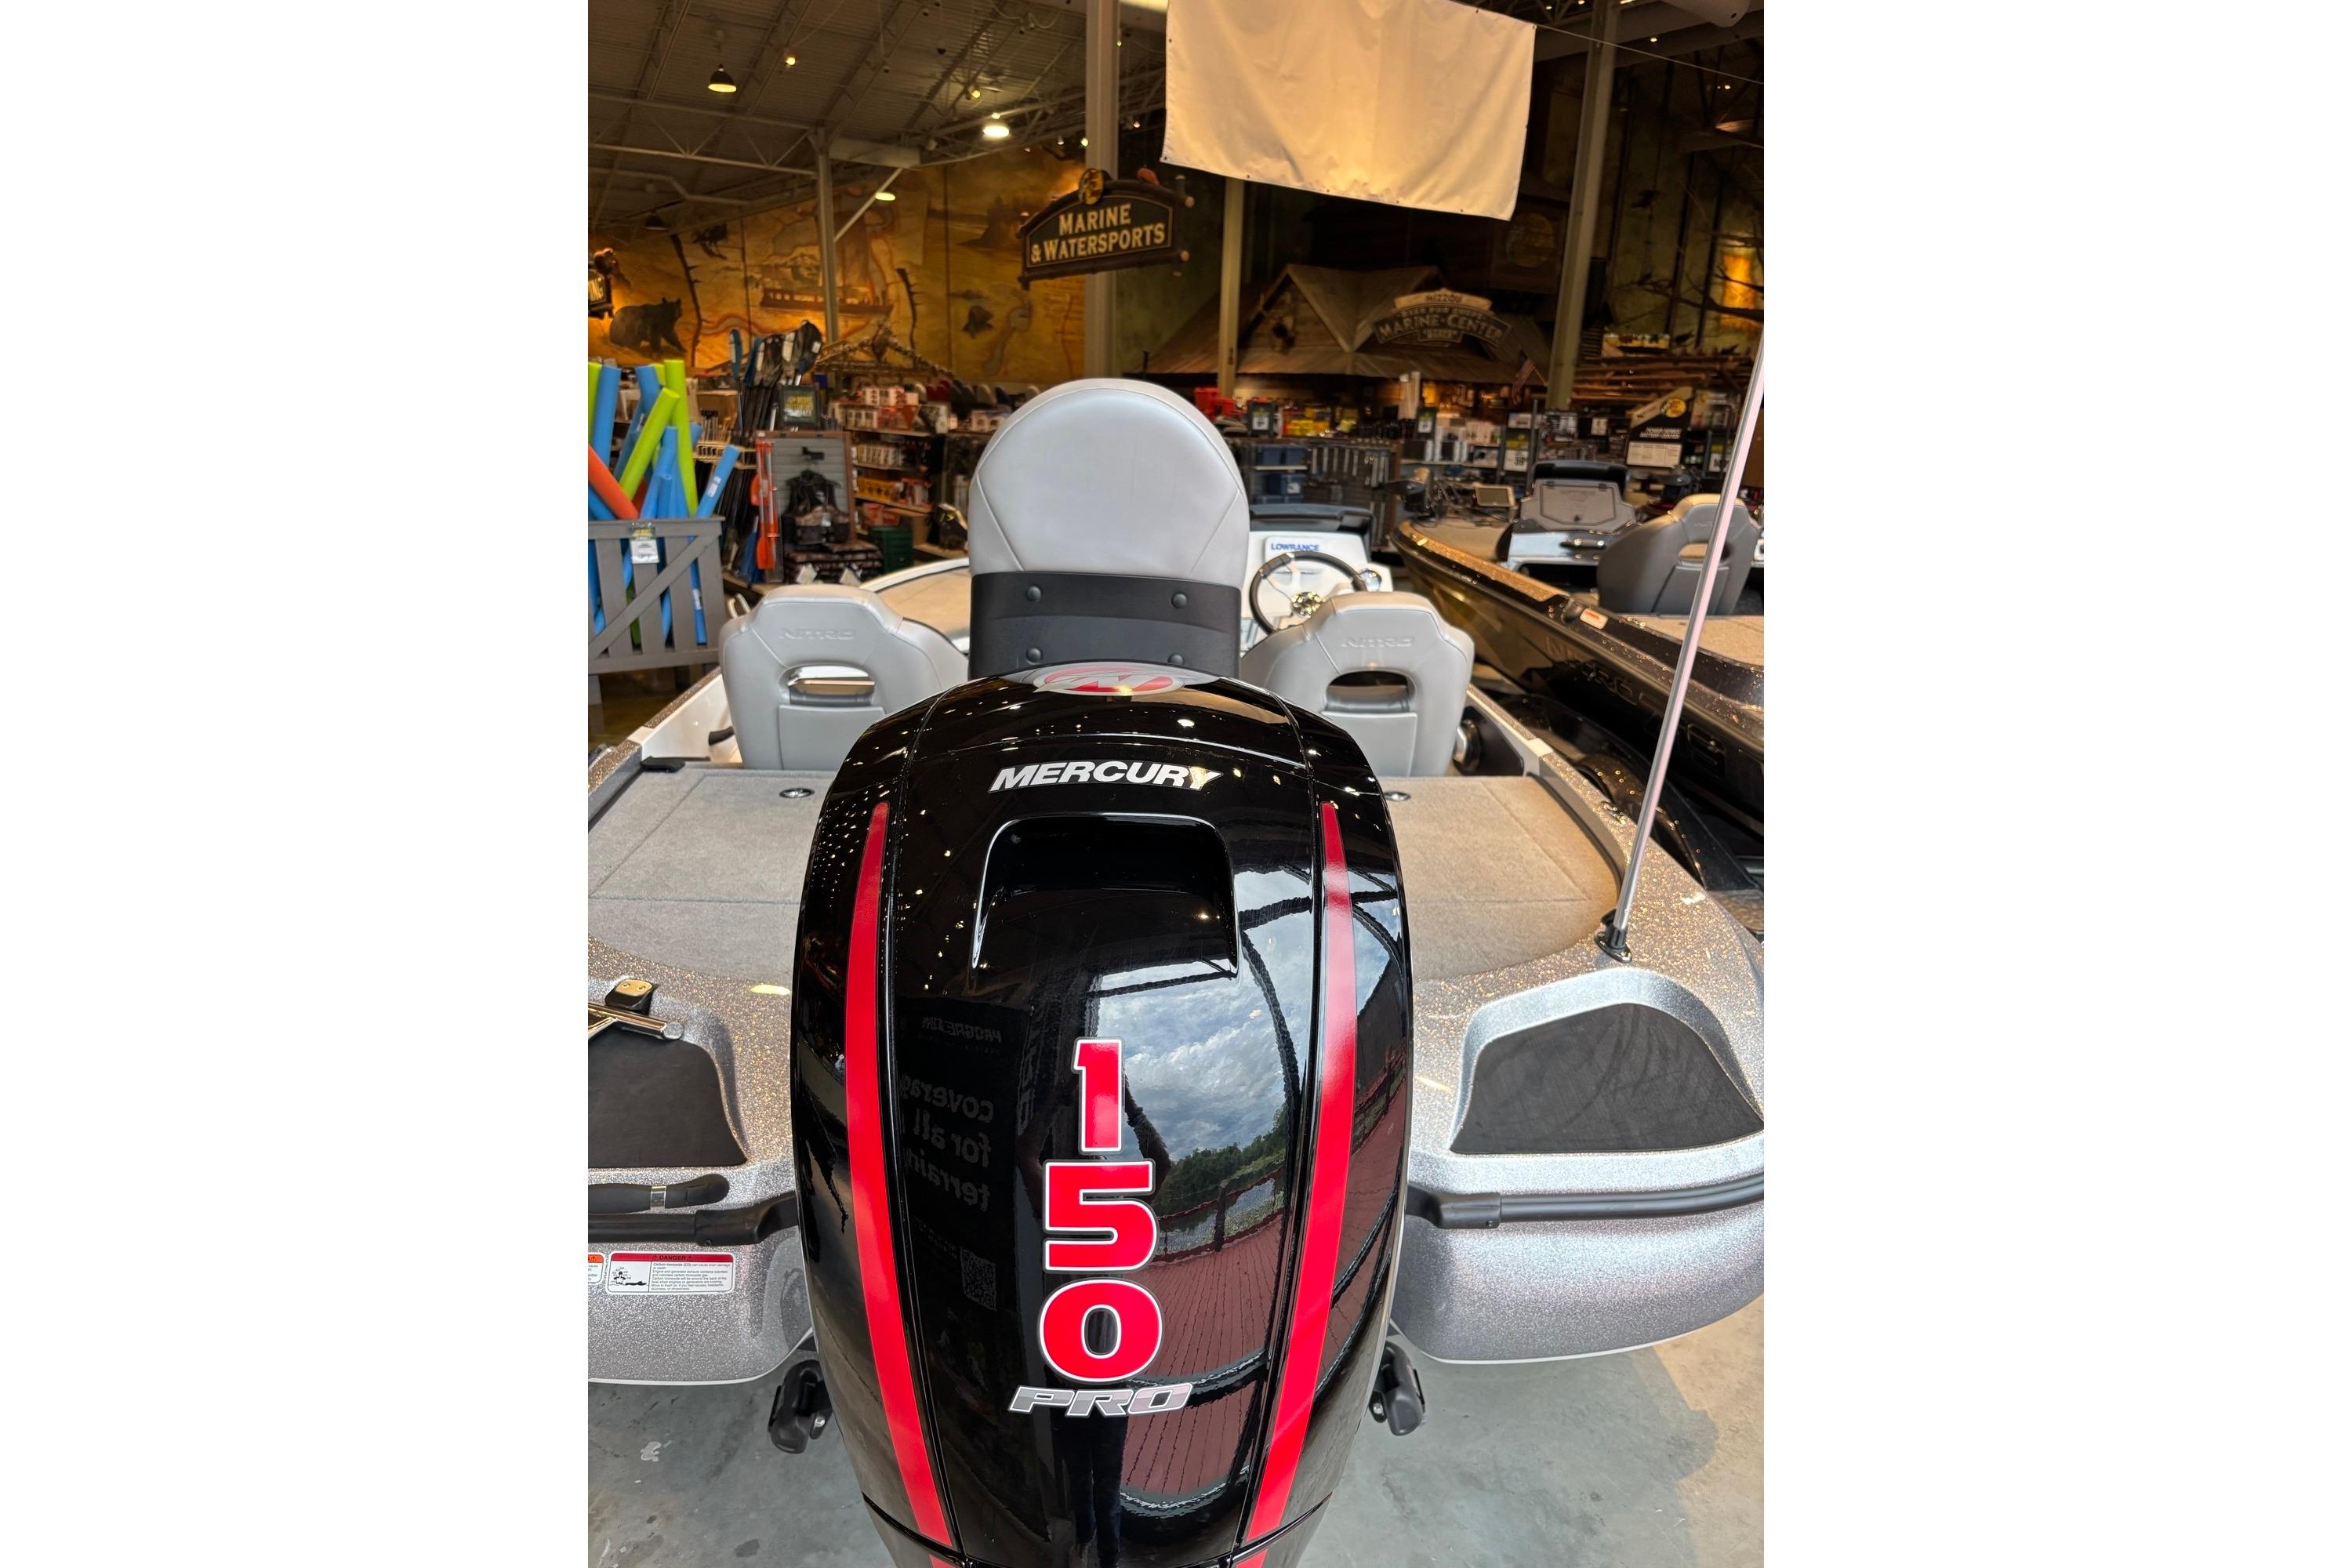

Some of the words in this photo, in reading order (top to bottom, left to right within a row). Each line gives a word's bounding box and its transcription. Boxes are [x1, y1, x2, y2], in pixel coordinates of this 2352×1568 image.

[1059, 202, 1131, 235] MARINE
[1031, 244, 1041, 263] &
[1044, 223, 1166, 261] WATERSPORTS
[1271, 543, 1320, 553] LOWRANCE
[989, 760, 1223, 792] MERCURY
[1009, 1383, 1192, 1417] PRO
